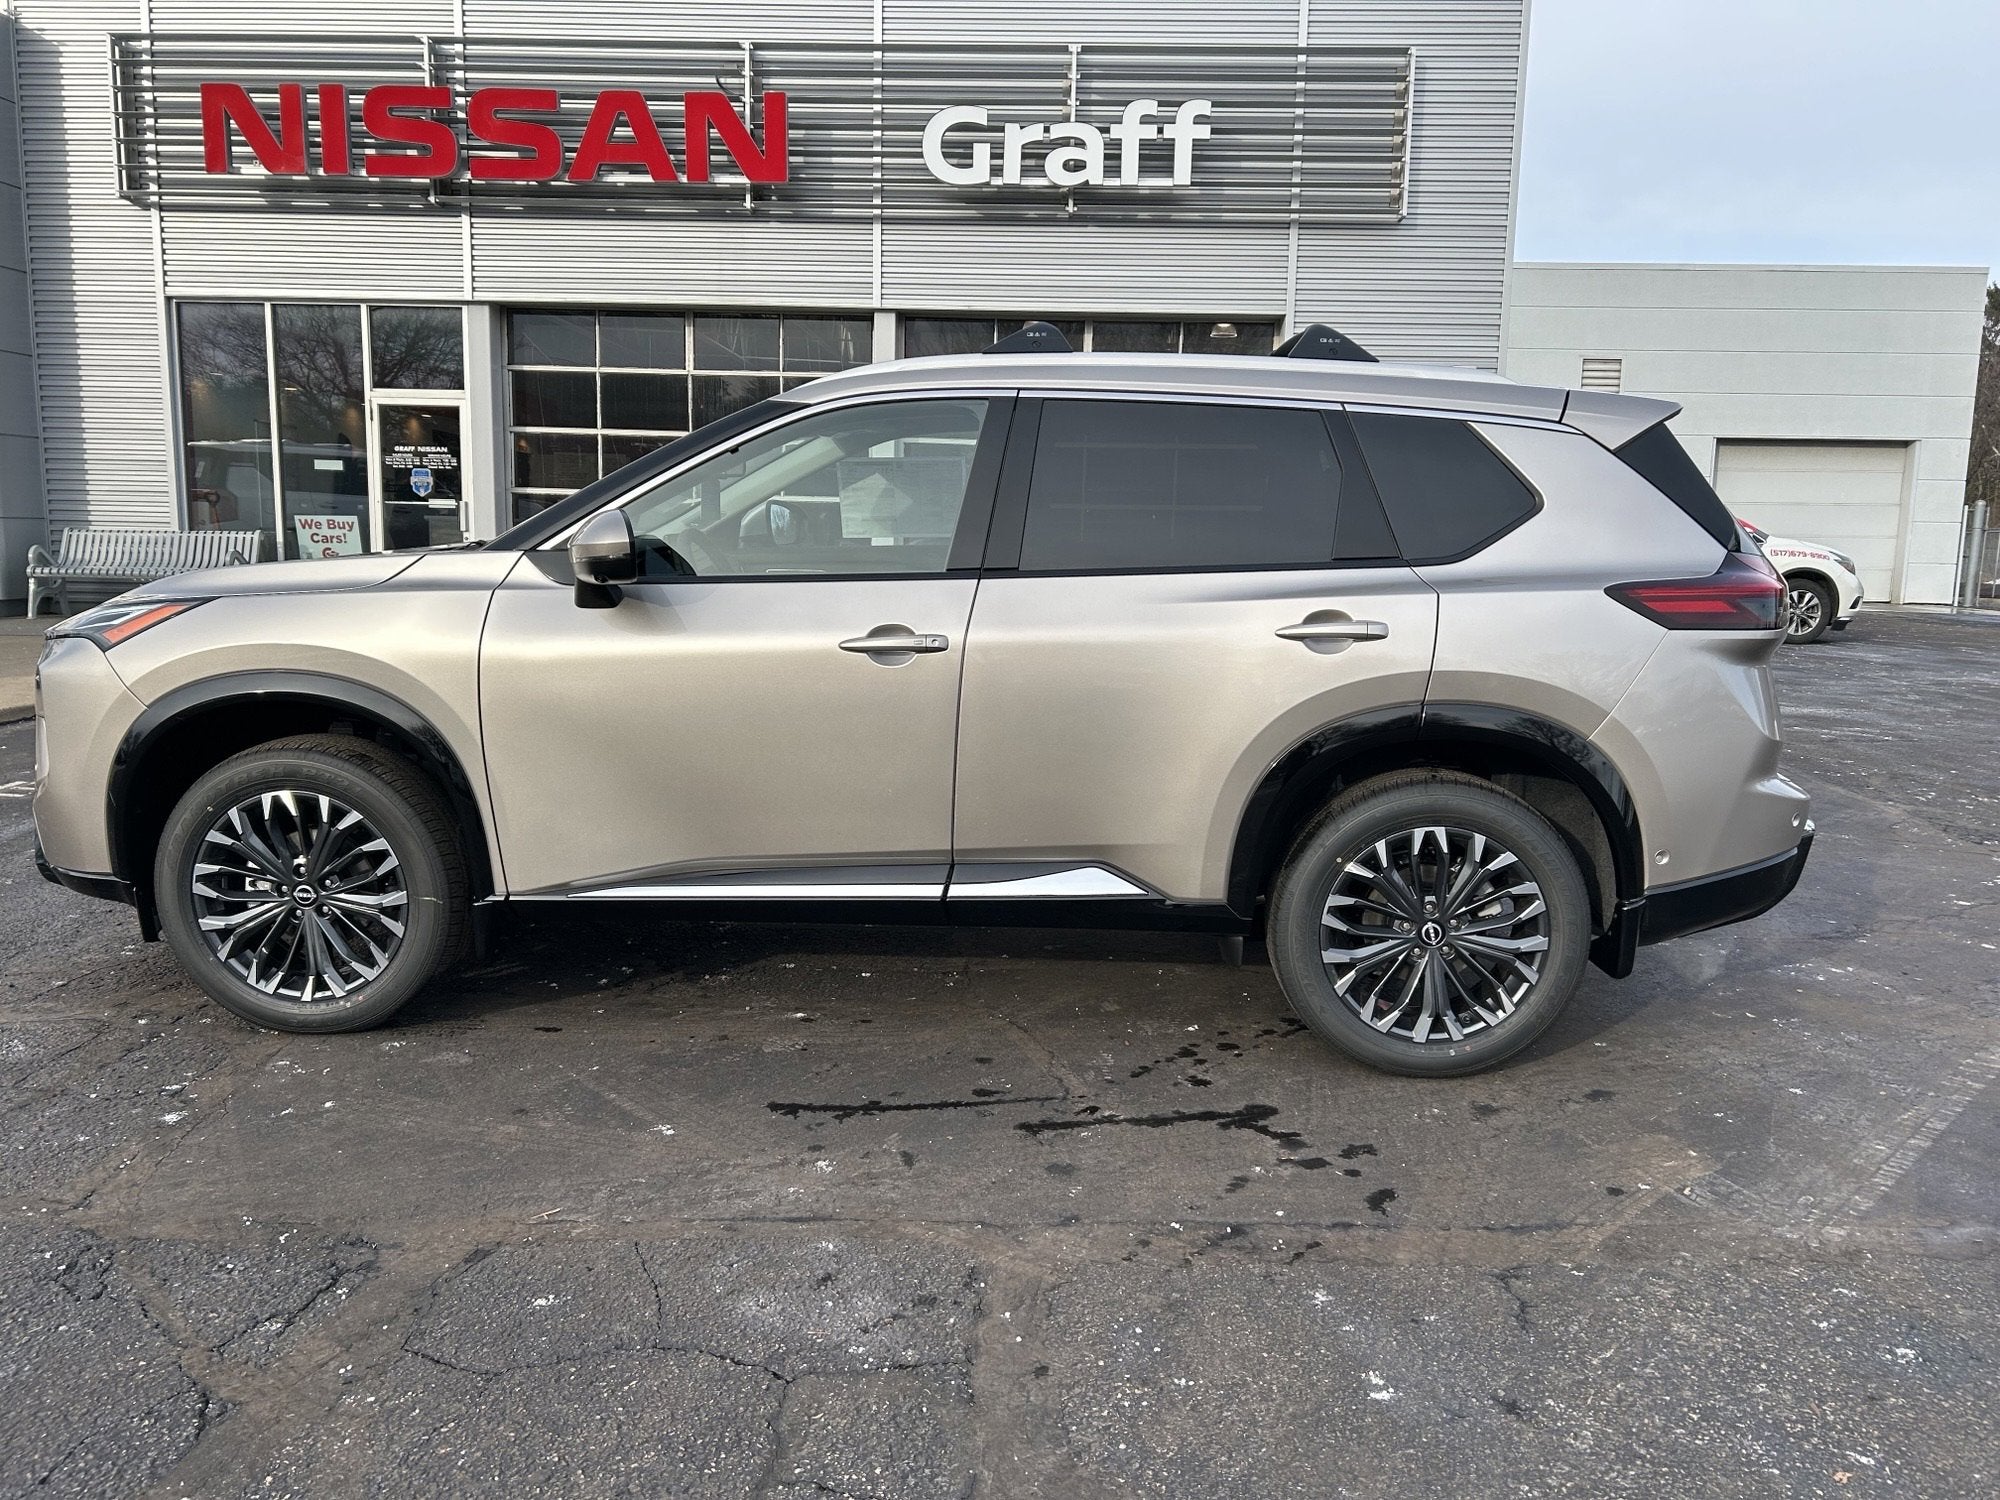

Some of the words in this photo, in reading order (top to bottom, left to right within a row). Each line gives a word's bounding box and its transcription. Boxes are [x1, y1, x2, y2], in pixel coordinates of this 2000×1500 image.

[200, 83, 788, 183] NISSAN
[922, 99, 1212, 186] Graff
[298, 519, 322, 530] We
[326, 519, 354, 532] Buy
[310, 532, 348, 544] Cars!
